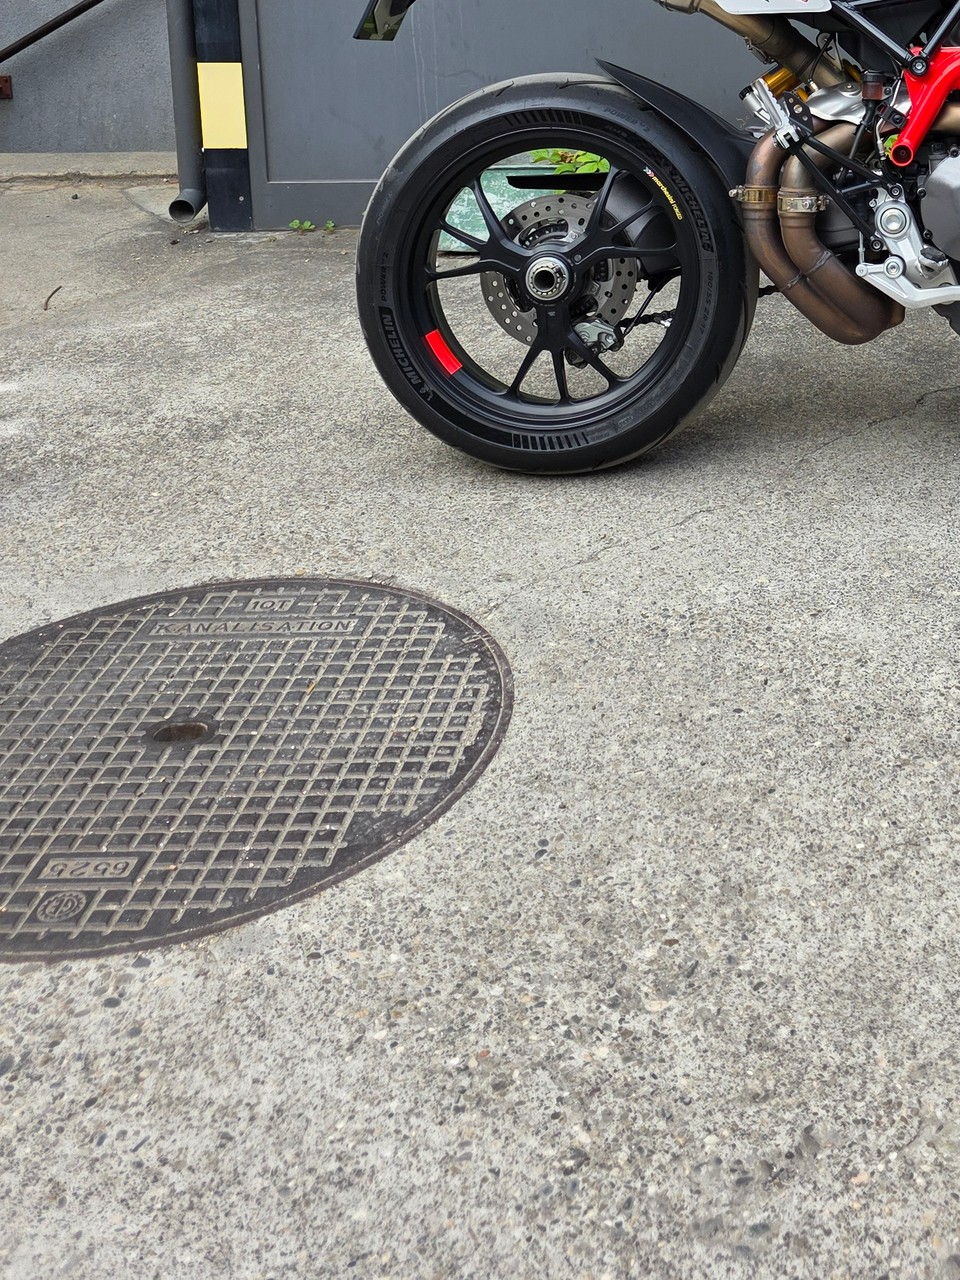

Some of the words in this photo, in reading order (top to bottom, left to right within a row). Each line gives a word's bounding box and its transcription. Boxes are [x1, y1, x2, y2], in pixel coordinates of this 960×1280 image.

[652, 176, 676, 205] marchesini
[381, 314, 421, 389] MICHELIN
[250, 599, 291, 610] 10T
[154, 621, 350, 634] KANALISATION
[49, 861, 129, 877] 6525
